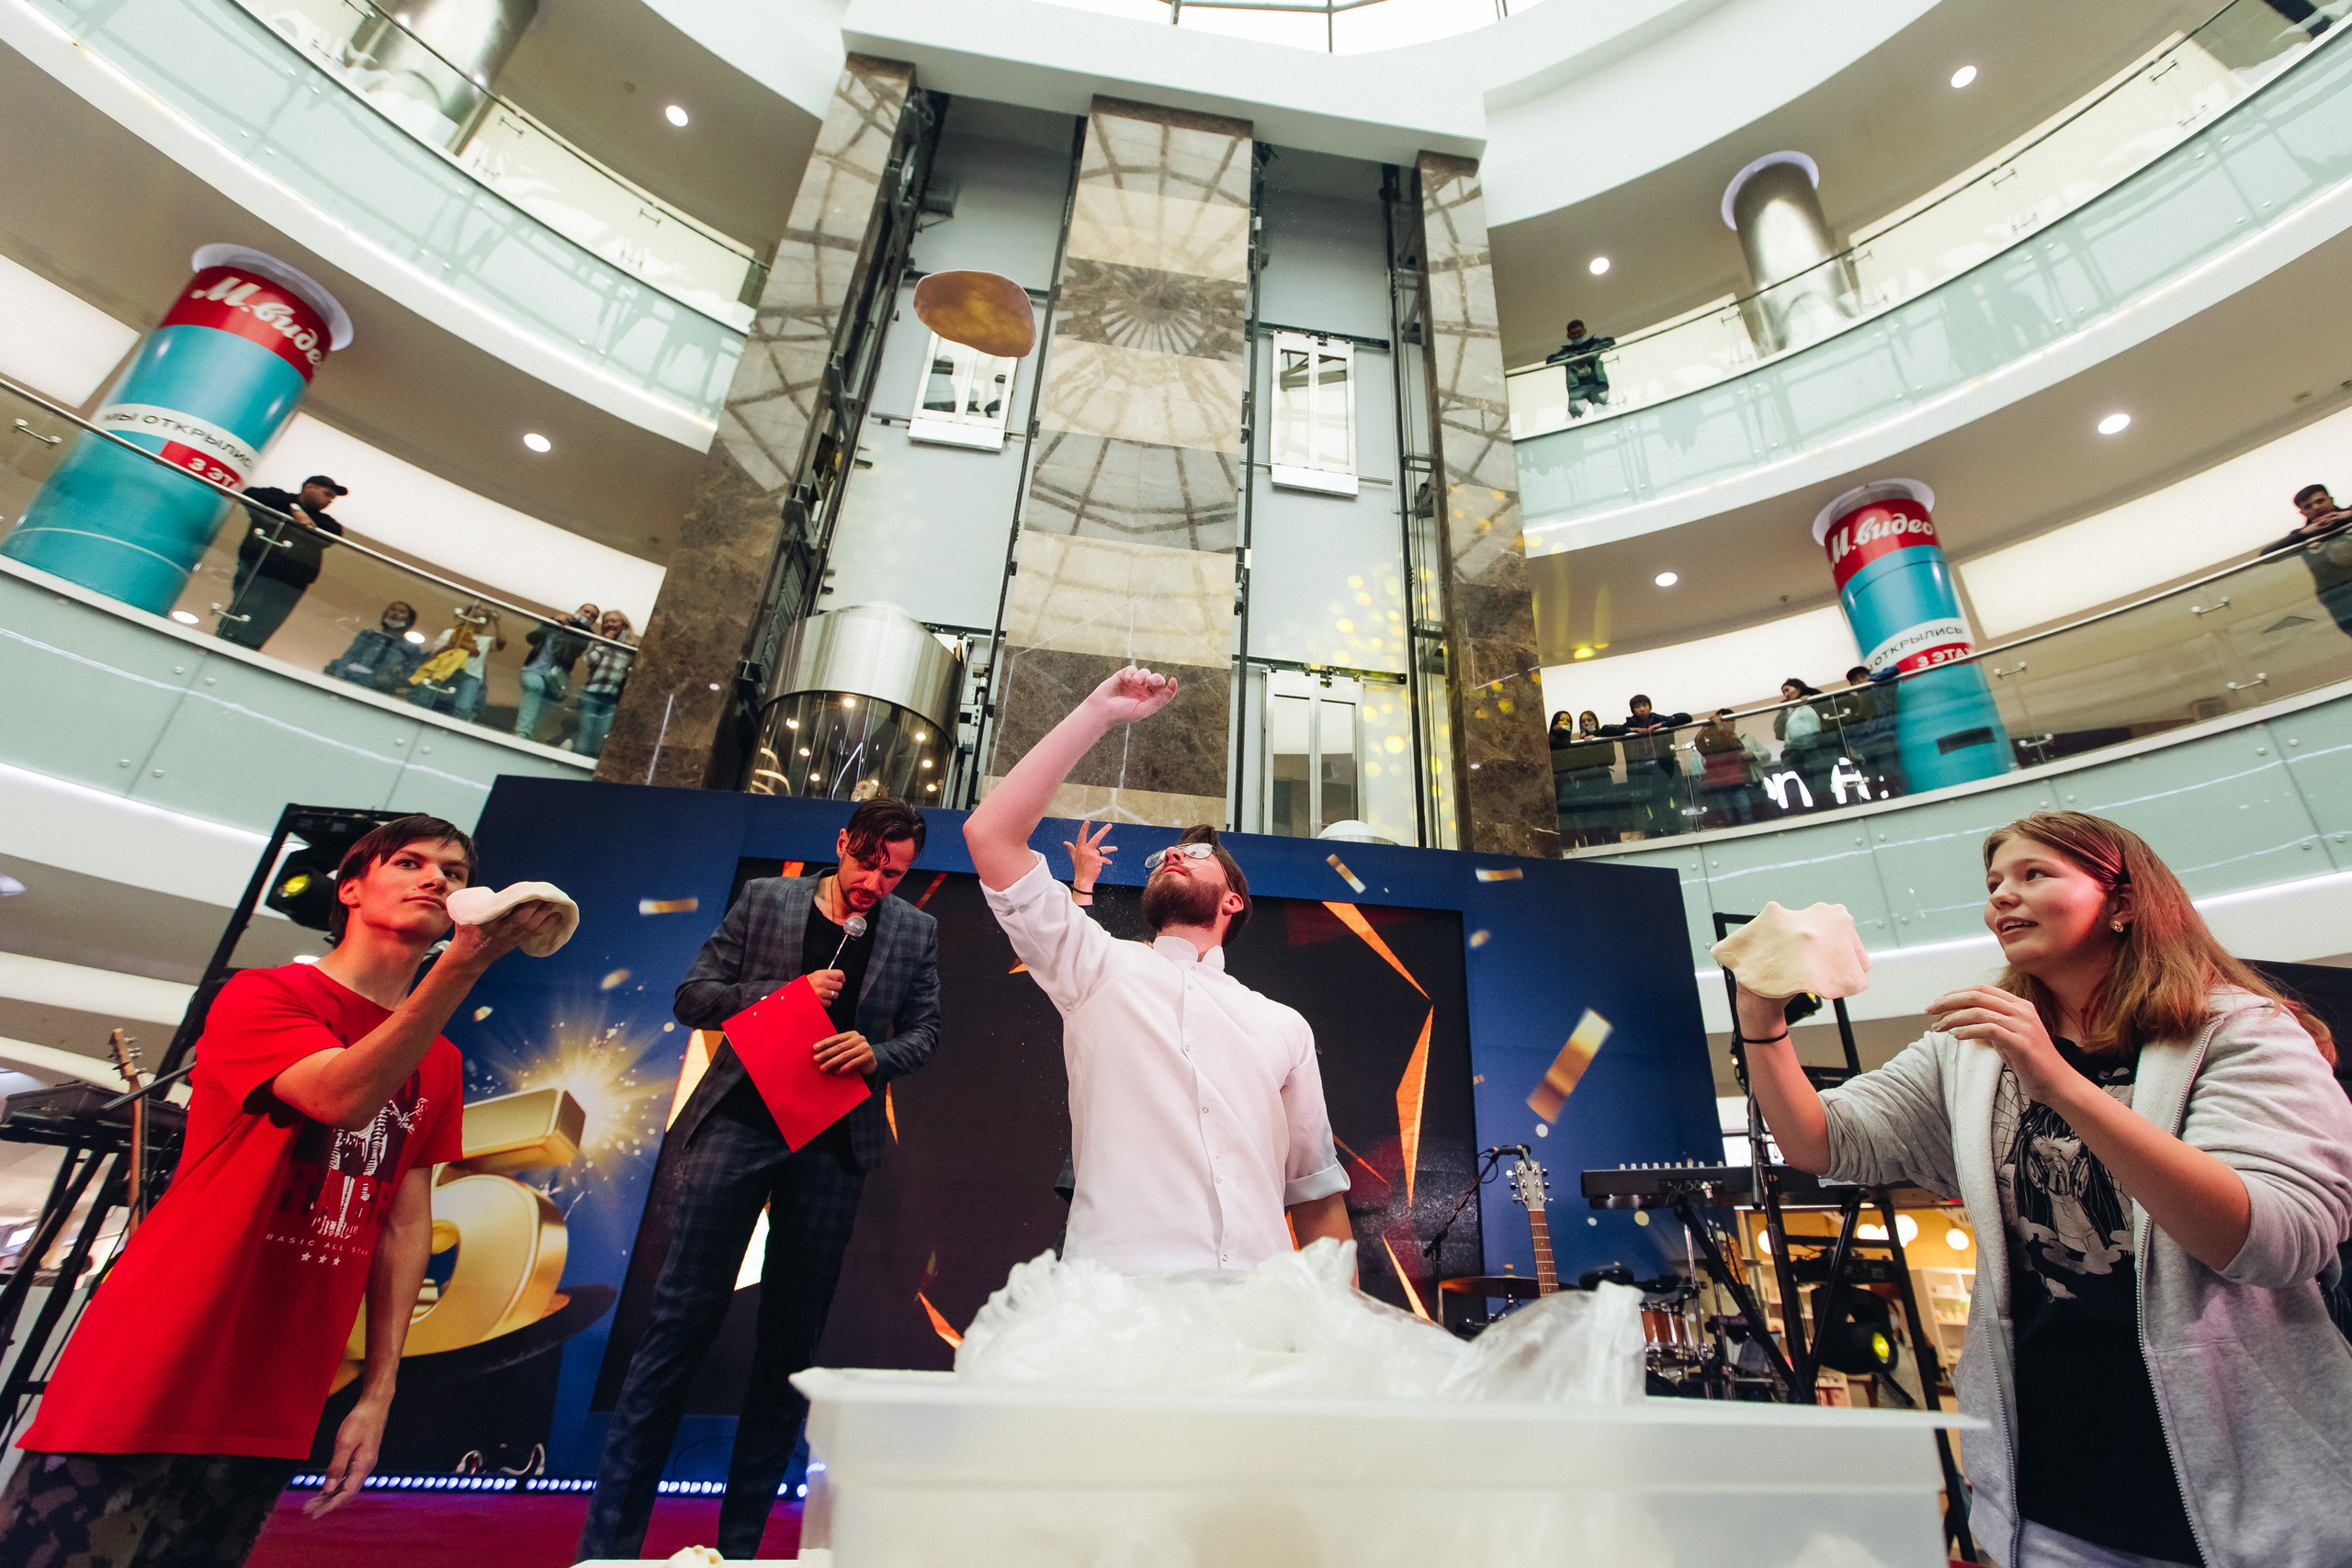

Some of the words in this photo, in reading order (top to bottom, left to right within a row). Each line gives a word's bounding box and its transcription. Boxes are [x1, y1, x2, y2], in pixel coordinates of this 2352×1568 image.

[191, 276, 322, 366] М.виде
[266, 1234, 315, 1247] BASIC
[324, 1242, 344, 1251] ALL
